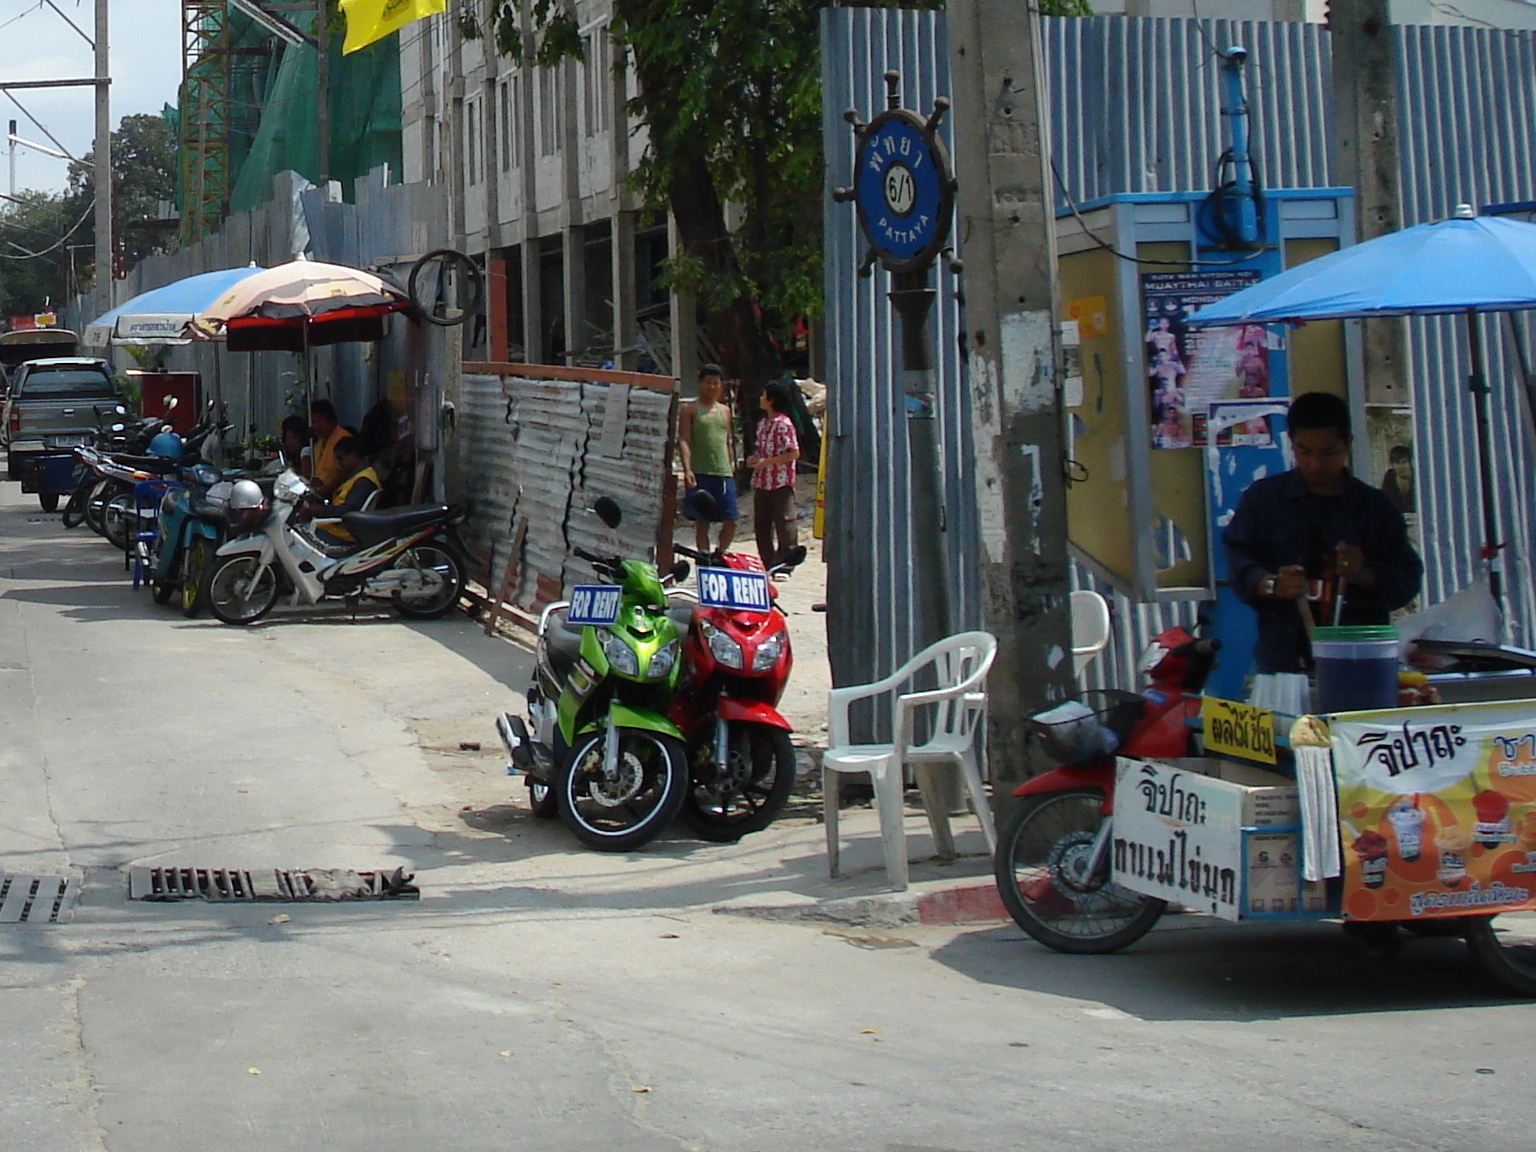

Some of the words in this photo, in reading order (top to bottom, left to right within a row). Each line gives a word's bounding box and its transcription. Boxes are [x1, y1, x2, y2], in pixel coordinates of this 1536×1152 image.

[869, 135, 923, 172] พัทยา
[888, 174, 912, 203] 6/1
[878, 214, 929, 244] PATTAYA
[1145, 280, 1210, 289] MUAYTHAI
[701, 573, 728, 601] FOR
[732, 576, 766, 606] RENT
[570, 590, 591, 618] FOR
[591, 590, 619, 624] RENT
[1356, 719, 1467, 776] จิปาถะ
[1135, 765, 1207, 825] จิปาถะ
